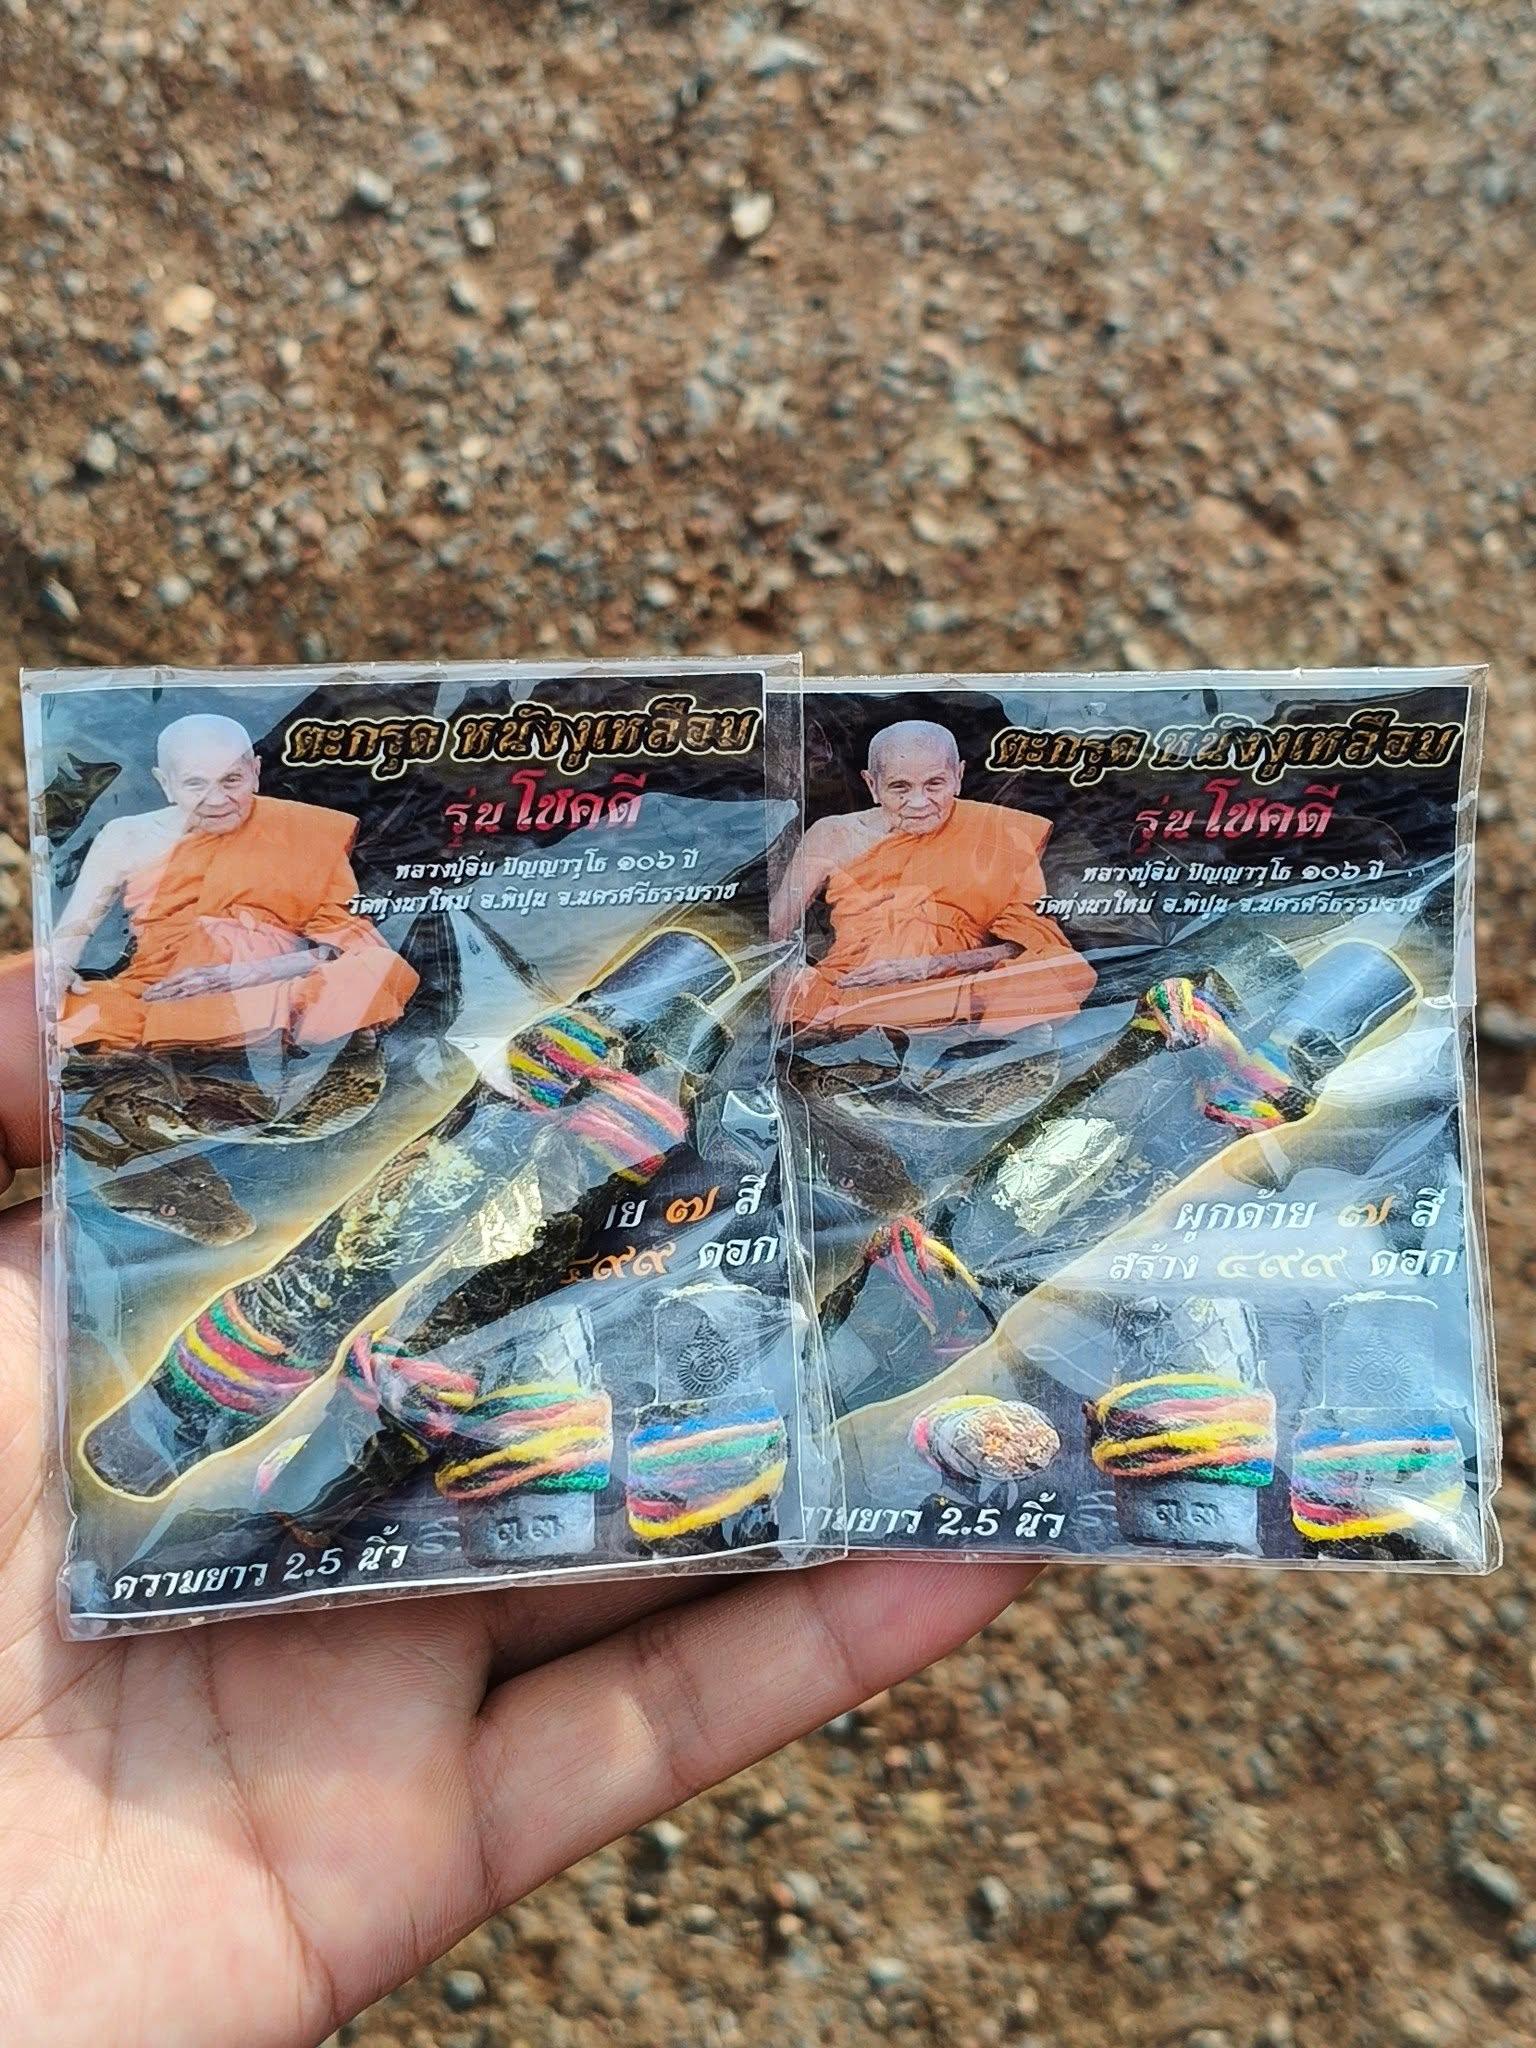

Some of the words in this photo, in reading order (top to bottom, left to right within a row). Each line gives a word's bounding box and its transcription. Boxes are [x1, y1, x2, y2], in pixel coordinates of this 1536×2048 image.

[284, 716, 448, 779] ตะกรุด
[985, 725, 1149, 787] ตะกรุด
[616, 850, 676, 872] ๑๐๖
[681, 848, 700, 869] ปี
[1301, 860, 1361, 881] ๑๐๖
[1367, 859, 1385, 880] ปี
[664, 1185, 720, 1224] ๗
[734, 1172, 768, 1216] สี
[1172, 1187, 1318, 1244] ผูกด้าย
[1337, 1195, 1396, 1228] ๗
[1410, 1186, 1447, 1228] สี
[697, 1235, 779, 1270] ดอก
[1108, 1239, 1199, 1280] สร้าง
[1216, 1245, 1349, 1281] ๔๙๙
[1369, 1248, 1457, 1278] ดอก
[936, 1508, 1001, 1537] 2.5
[1015, 1491, 1066, 1539] นิ้ว
[111, 1562, 268, 1601] ความยาว
[282, 1546, 344, 1582] 2.5
[357, 1524, 409, 1572] นิ้ว
